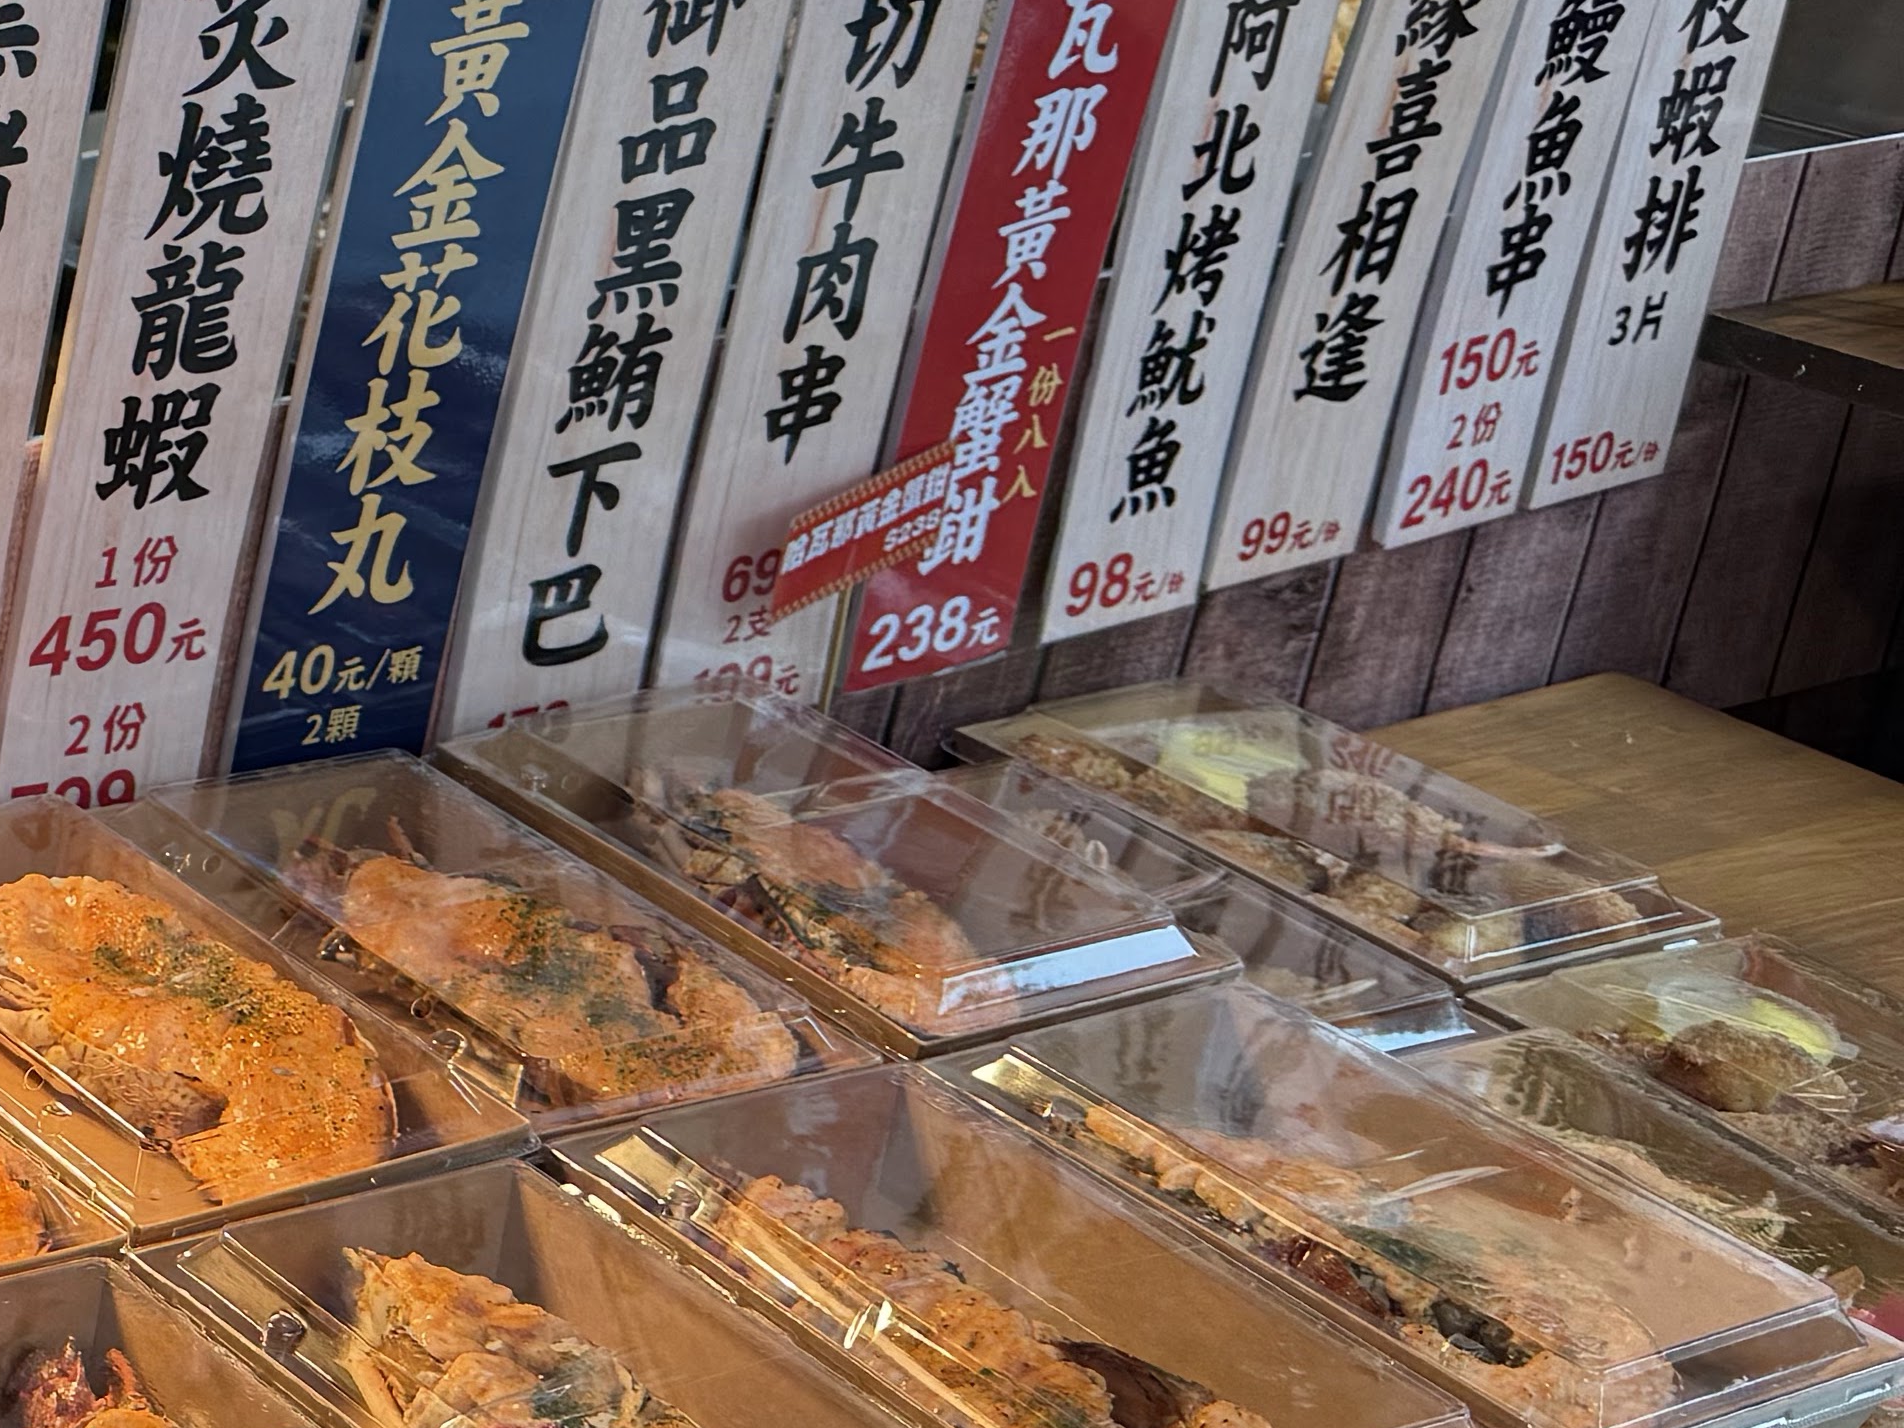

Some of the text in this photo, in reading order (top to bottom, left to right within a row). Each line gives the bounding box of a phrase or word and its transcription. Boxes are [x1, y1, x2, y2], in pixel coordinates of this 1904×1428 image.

[1608, 290, 1668, 346] 3片
[1439, 327, 1541, 396] 150元
[1446, 401, 1503, 450] 2份
[1399, 458, 1512, 530] 240元
[94, 535, 178, 590] 1份
[28, 601, 207, 678] 450元
[861, 595, 1001, 673] 238元
[262, 644, 424, 700] 40元/顆
[64, 701, 147, 757] 2份
[301, 704, 363, 746] 2顆
